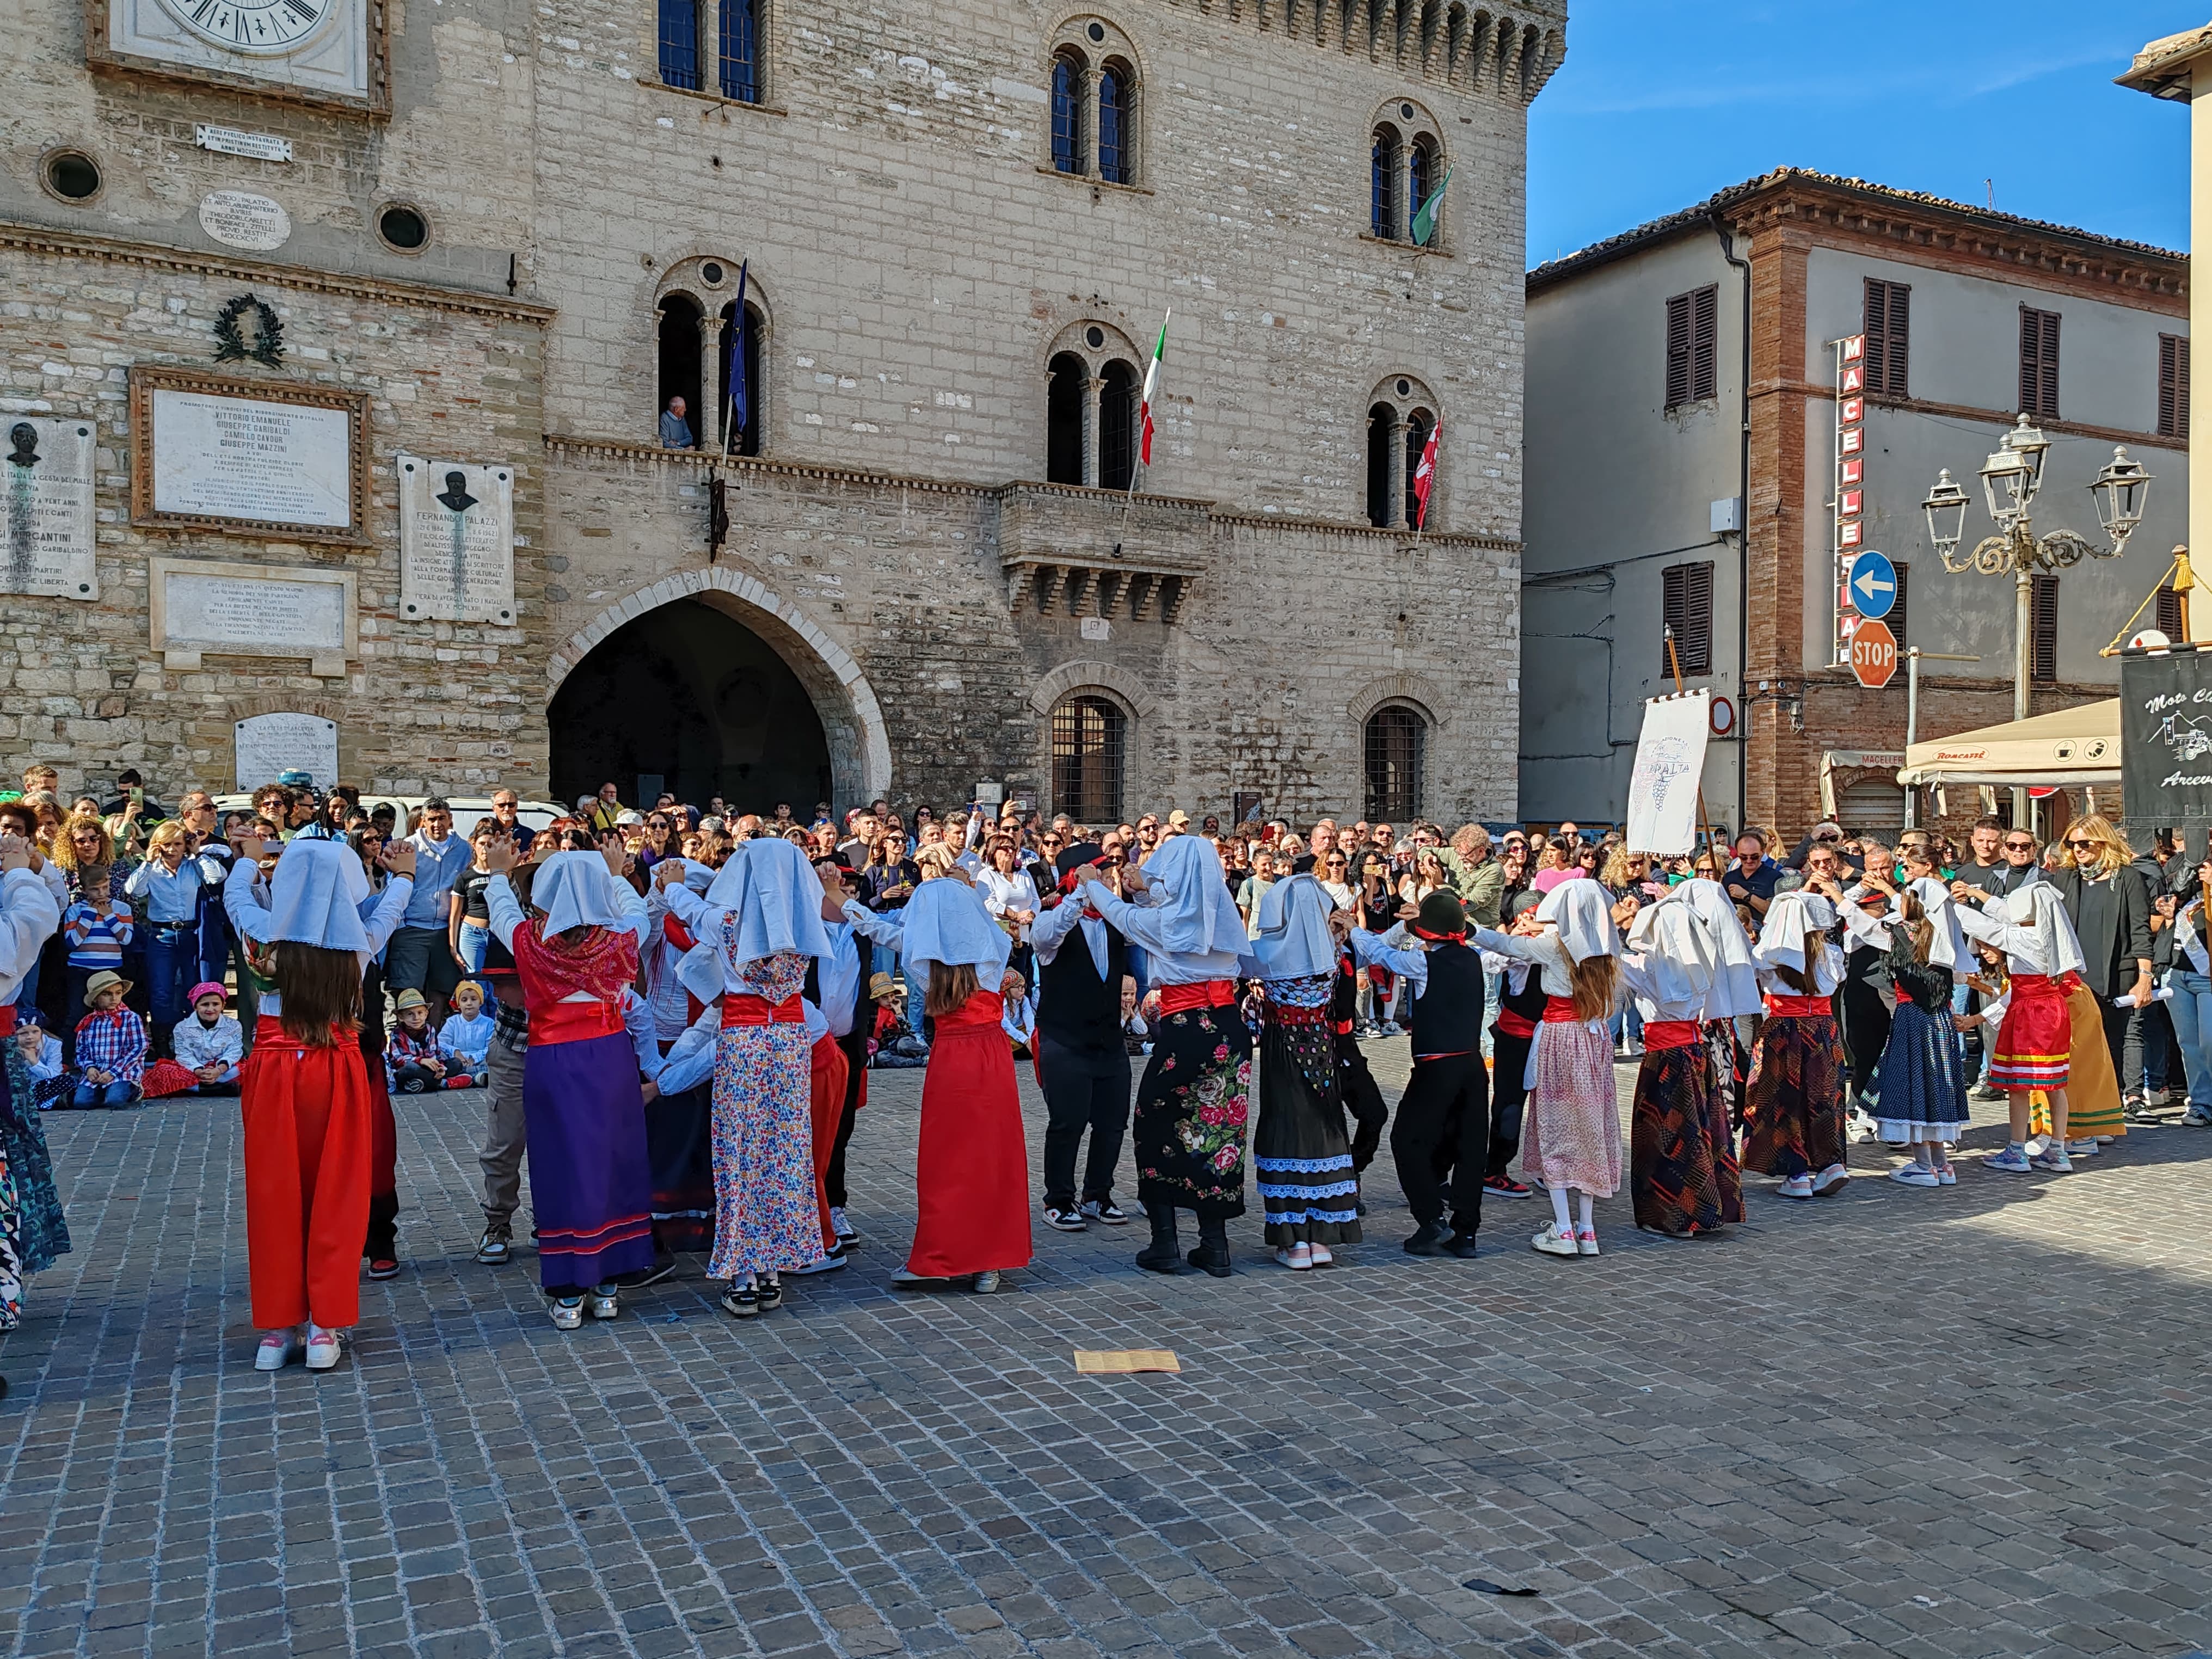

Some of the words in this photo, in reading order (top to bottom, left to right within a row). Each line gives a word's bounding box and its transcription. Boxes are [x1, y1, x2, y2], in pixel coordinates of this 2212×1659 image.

[216, 412, 249, 421] VITTORIO
[252, 416, 291, 426] EMANUELE
[217, 421, 251, 431] GIUSEPPE
[254, 425, 290, 435] GARIBALDI
[224, 431, 255, 440] CAMILLO
[257, 434, 283, 443] CAVOUR
[220, 439, 255, 449] GIUSEPPE
[258, 443, 287, 453] MAZZINI
[417, 512, 461, 523] FERNANDO
[465, 516, 497, 526] PALAZZI
[11, 531, 71, 542] MERCANTINI
[420, 533, 454, 541] FILOLOGO
[42, 546, 88, 554] GARIBALDINO
[471, 570, 502, 578] CULTURALE
[462, 577, 500, 586] GENERAZIONI
[1854, 641, 1894, 667] STOP
[2145, 692, 2187, 714] Moto
[1862, 755, 1906, 765] MACELLERI
